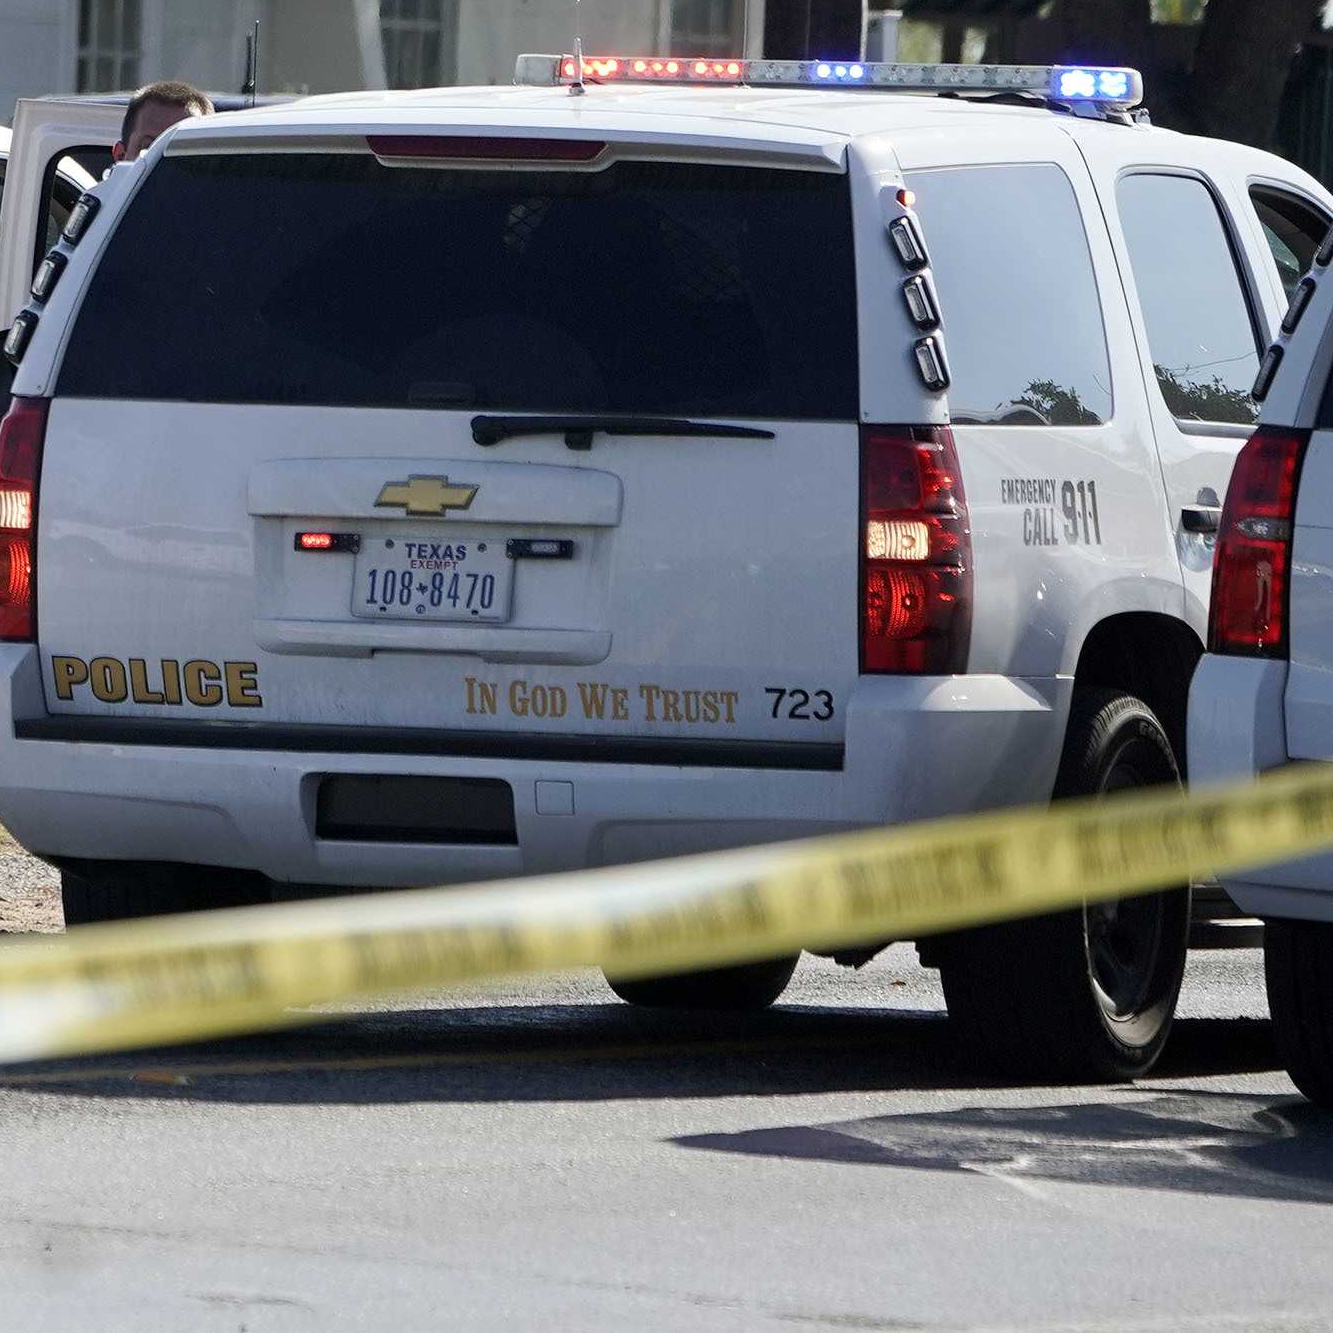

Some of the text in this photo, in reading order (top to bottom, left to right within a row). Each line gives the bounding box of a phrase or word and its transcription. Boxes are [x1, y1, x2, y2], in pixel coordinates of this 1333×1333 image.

[1000, 478, 1057, 505] EMERGENCY
[1023, 507, 1059, 547] CALL
[1061, 479, 1102, 546] 911
[404, 542, 467, 562] TEXAS
[410, 559, 460, 571] EXEMPT
[51, 655, 264, 708] POLICE
[764, 686, 835, 721] 723
